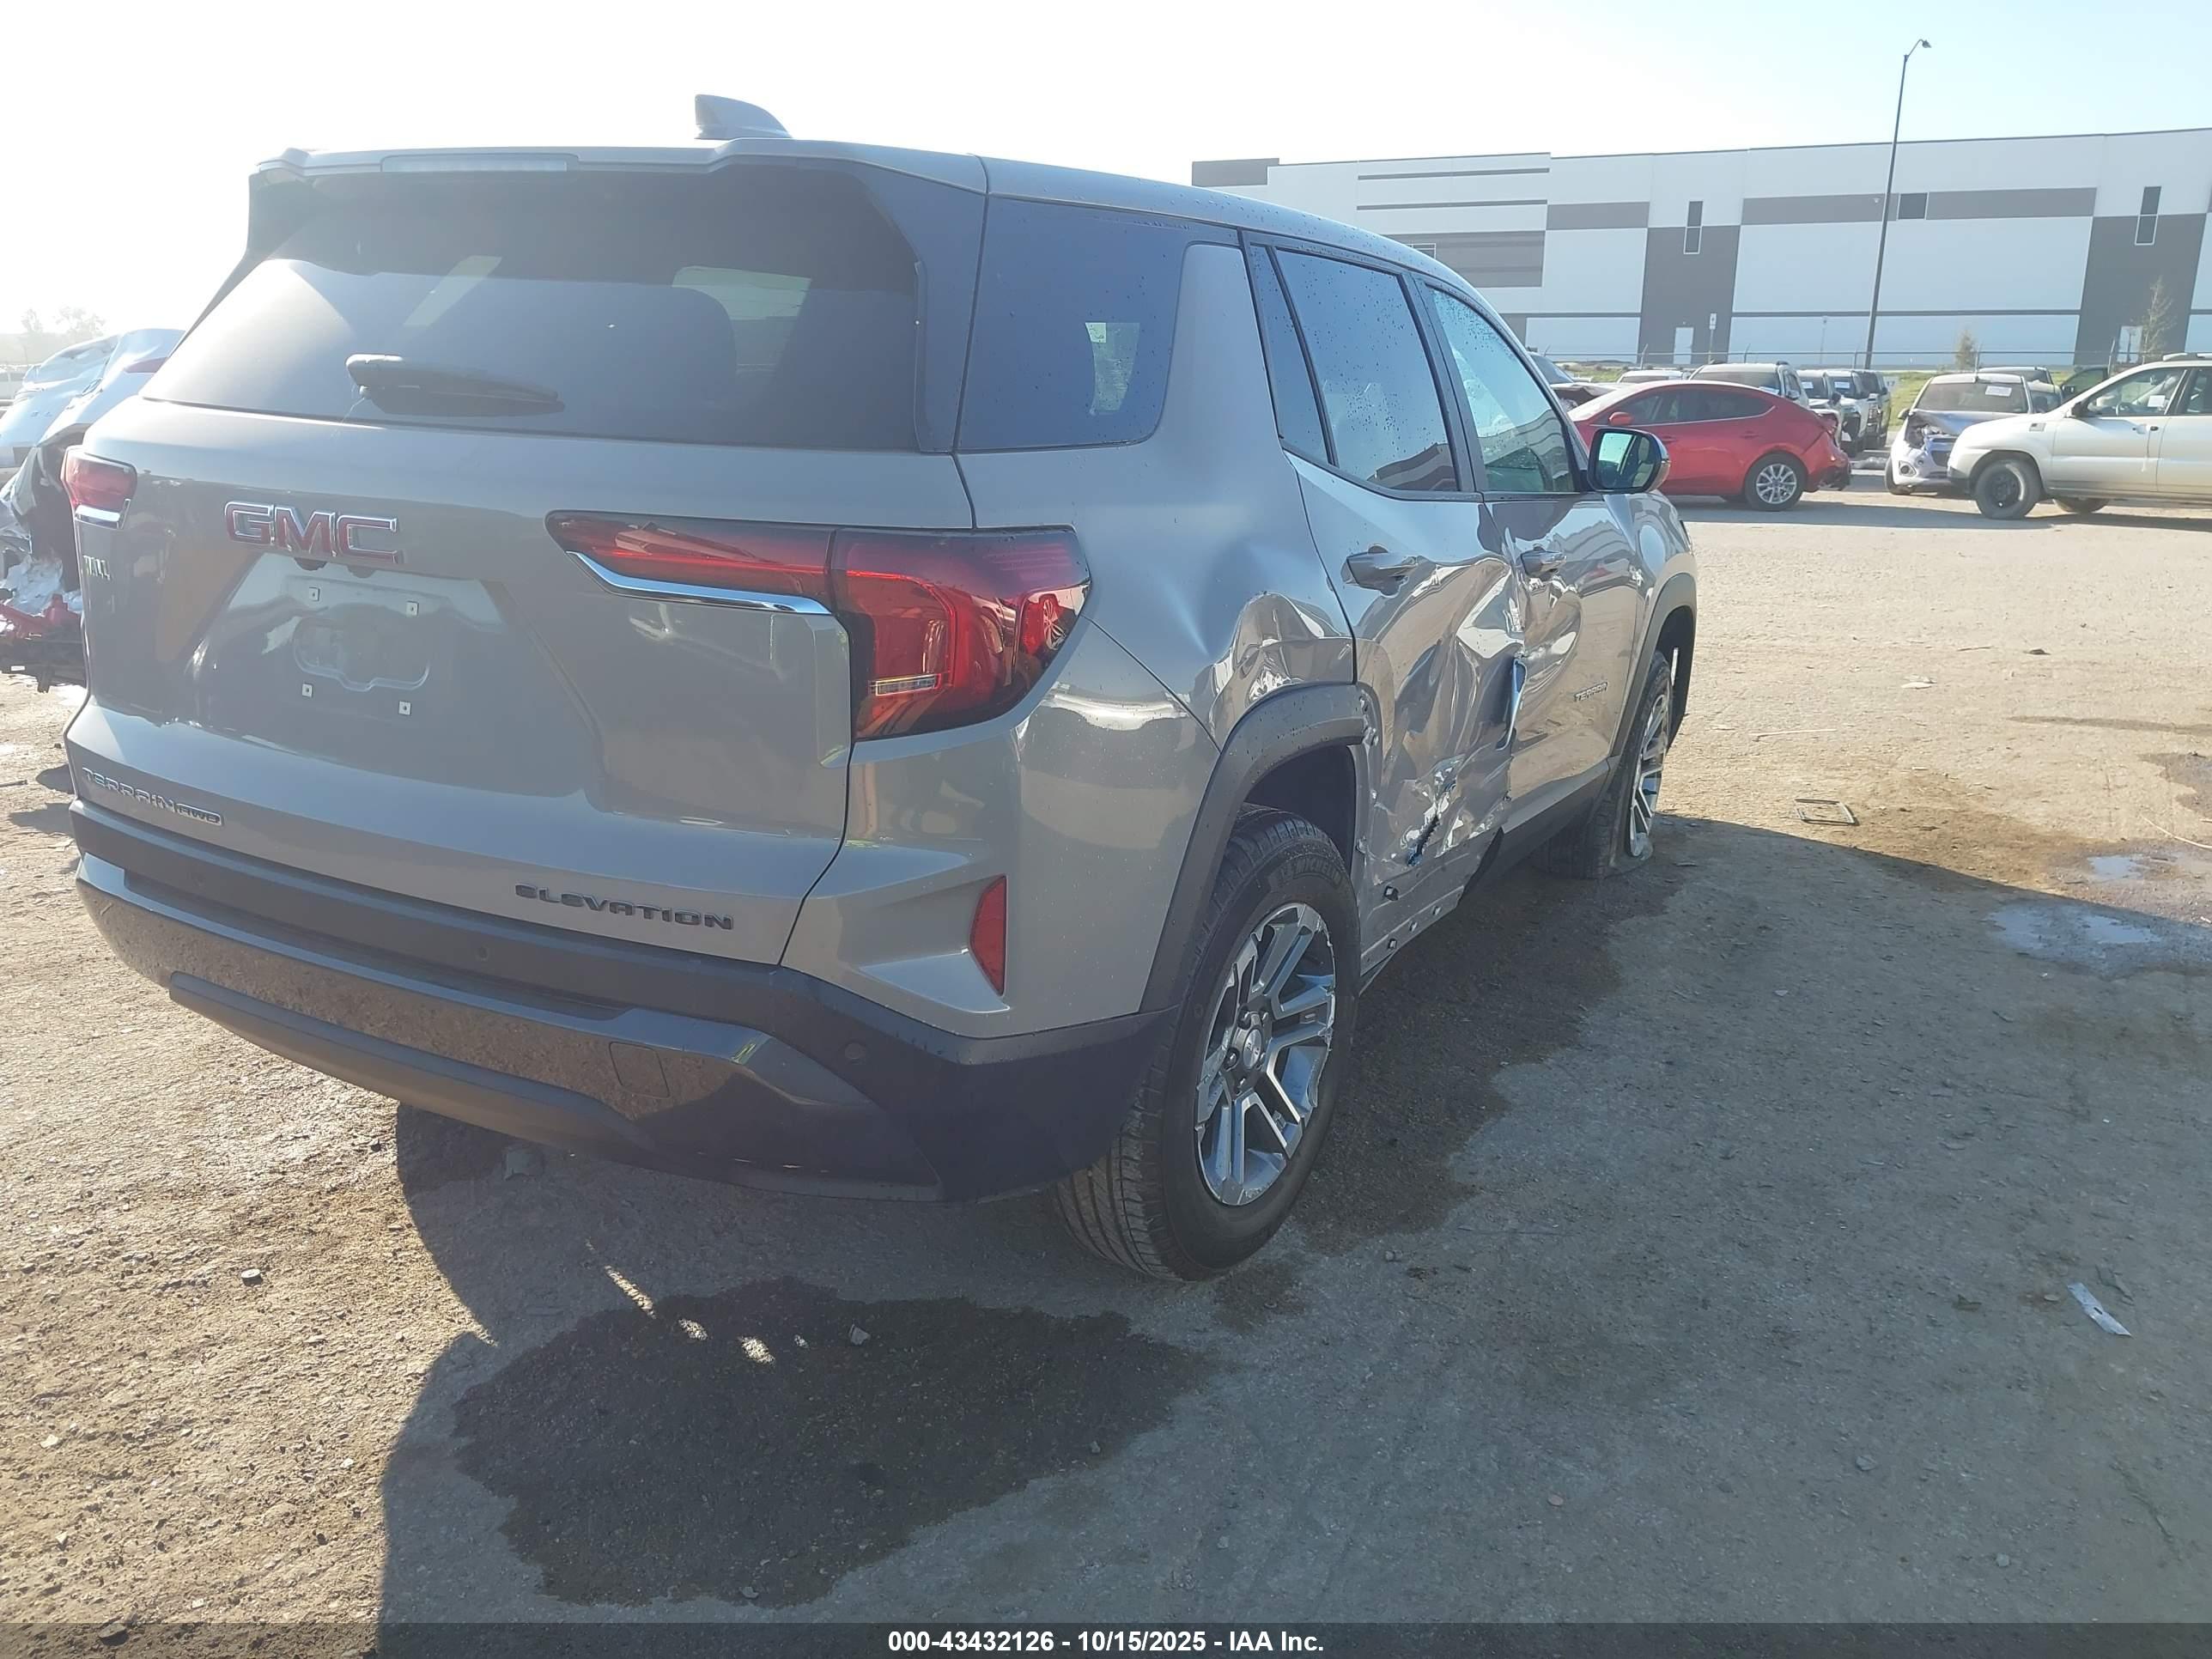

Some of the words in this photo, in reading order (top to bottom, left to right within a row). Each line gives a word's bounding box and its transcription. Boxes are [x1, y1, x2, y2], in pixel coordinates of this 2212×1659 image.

[224, 501, 398, 564] GMC
[82, 767, 175, 813] TERRAIN
[515, 884, 733, 931] ELEVATION
